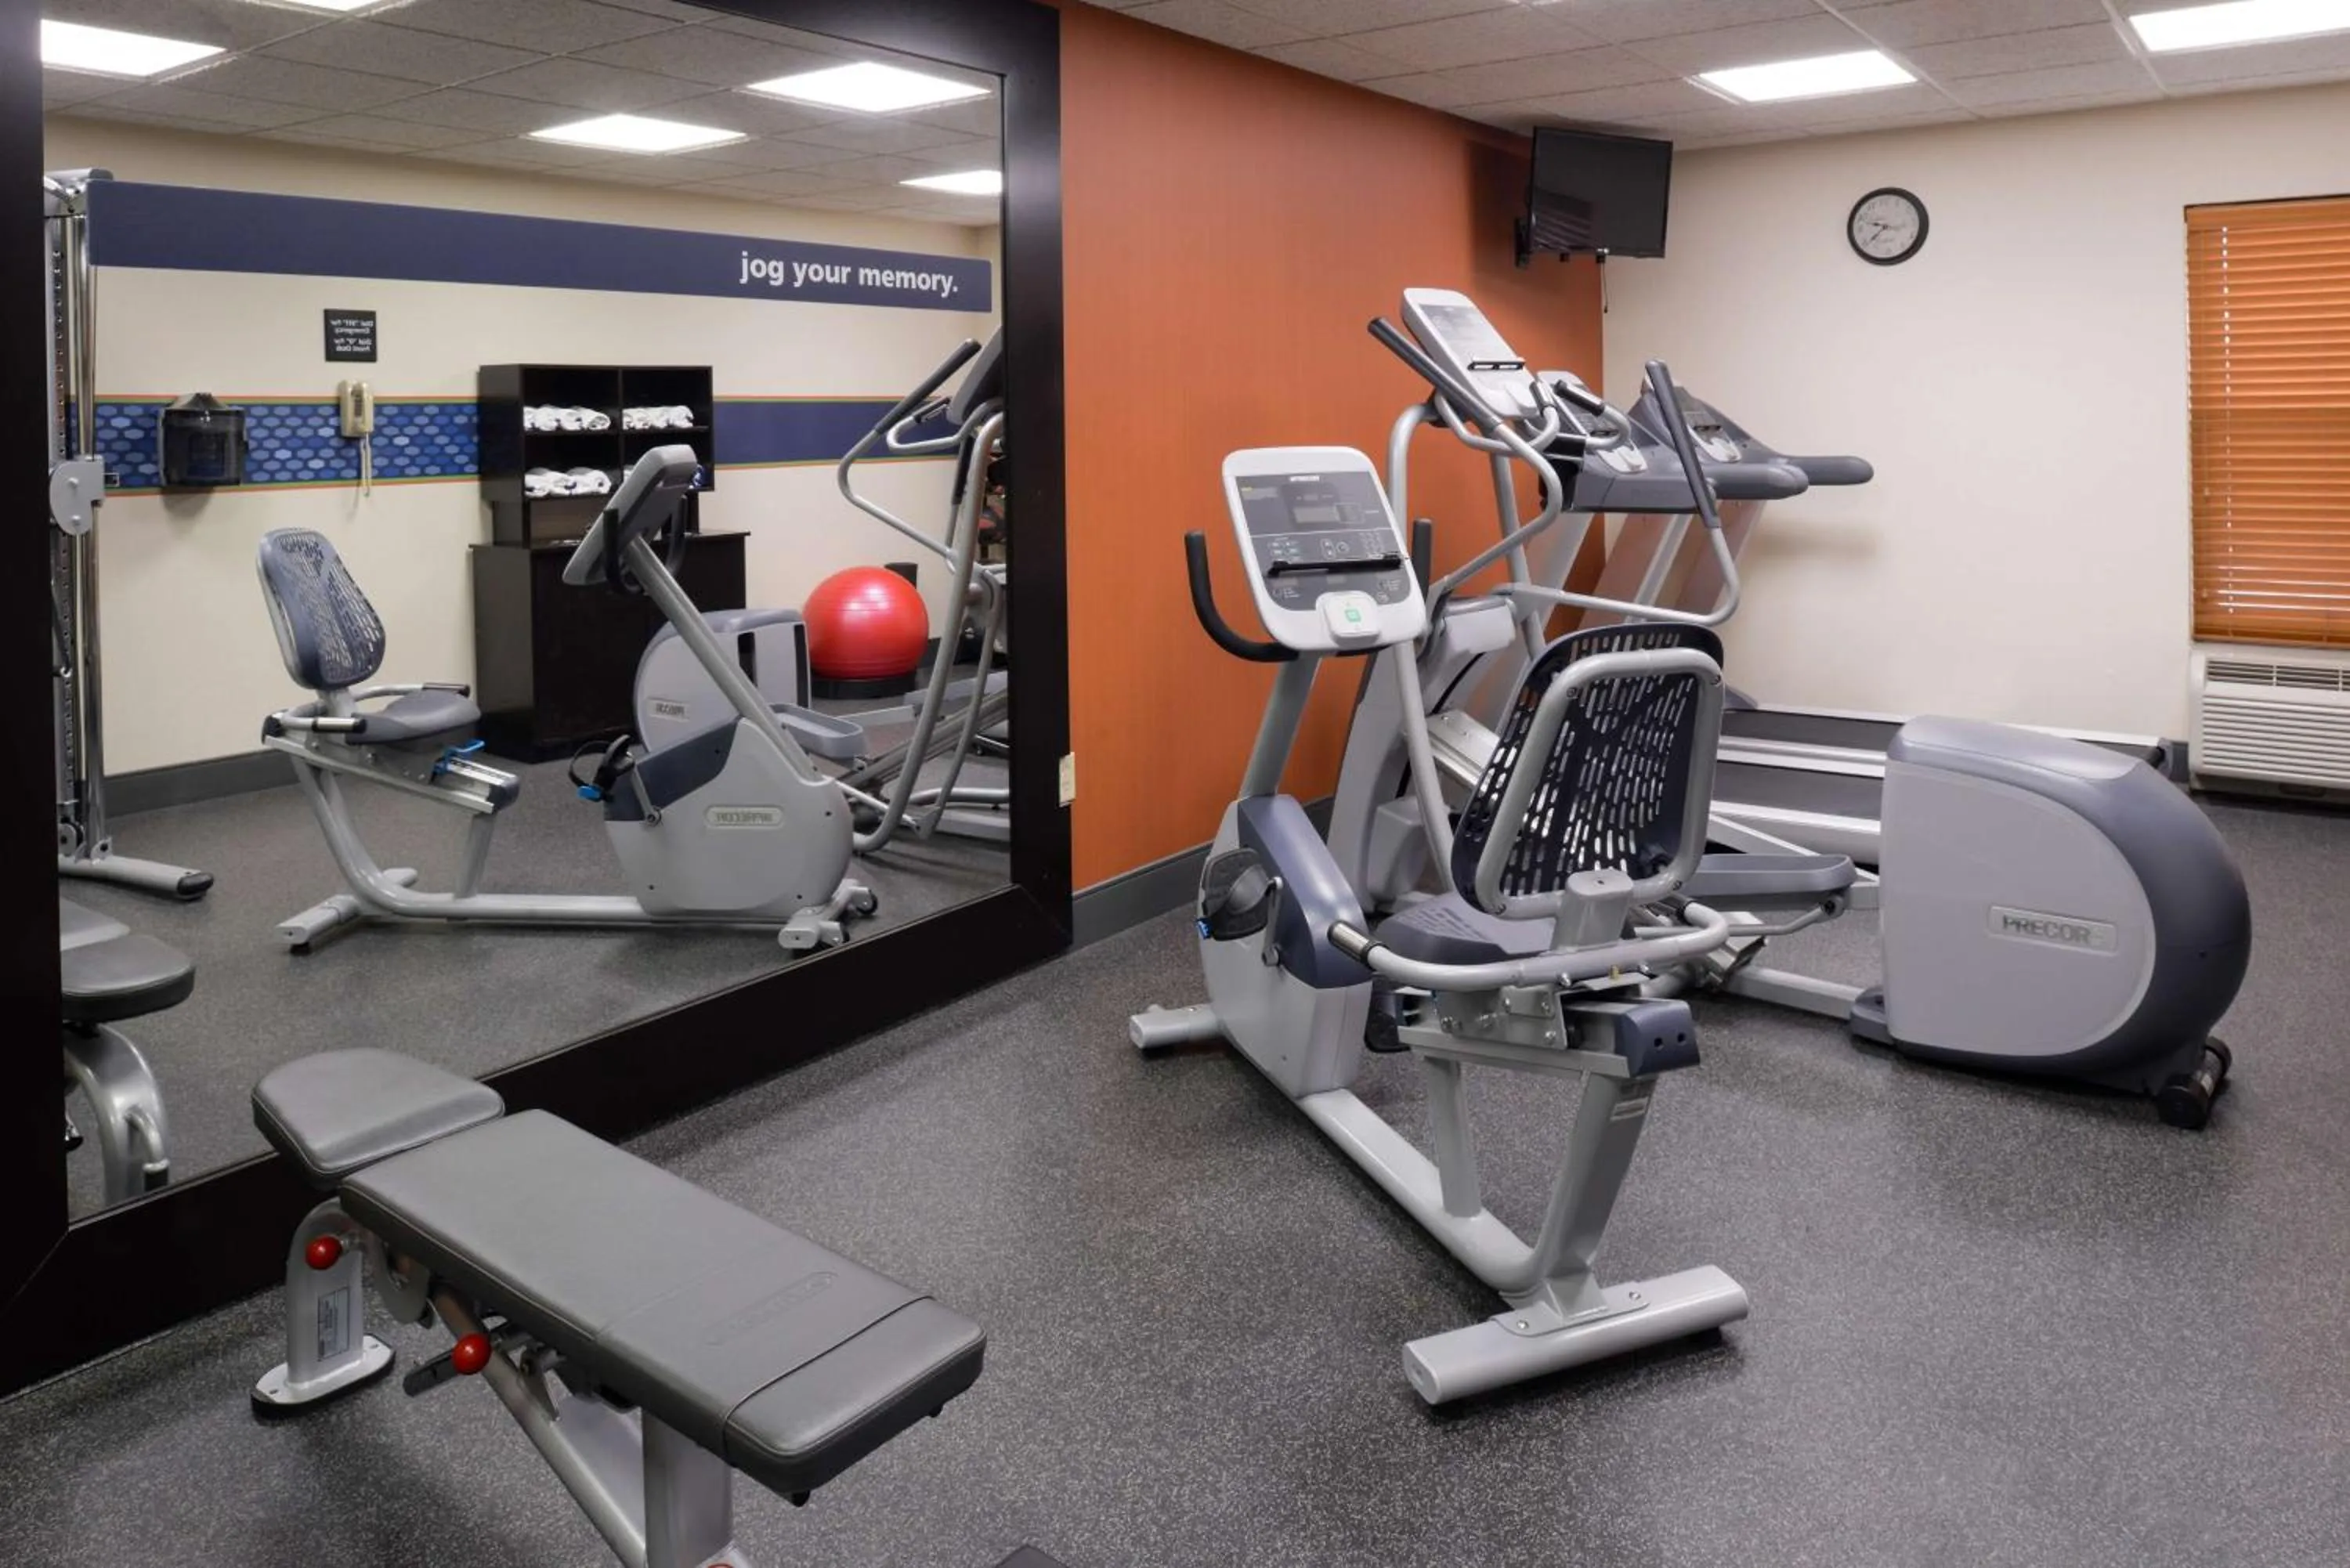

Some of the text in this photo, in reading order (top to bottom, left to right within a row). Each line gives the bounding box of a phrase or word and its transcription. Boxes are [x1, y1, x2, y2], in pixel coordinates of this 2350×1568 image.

[739, 251, 959, 298] jog your memory.
[2002, 914, 2092, 945] PRECOR
